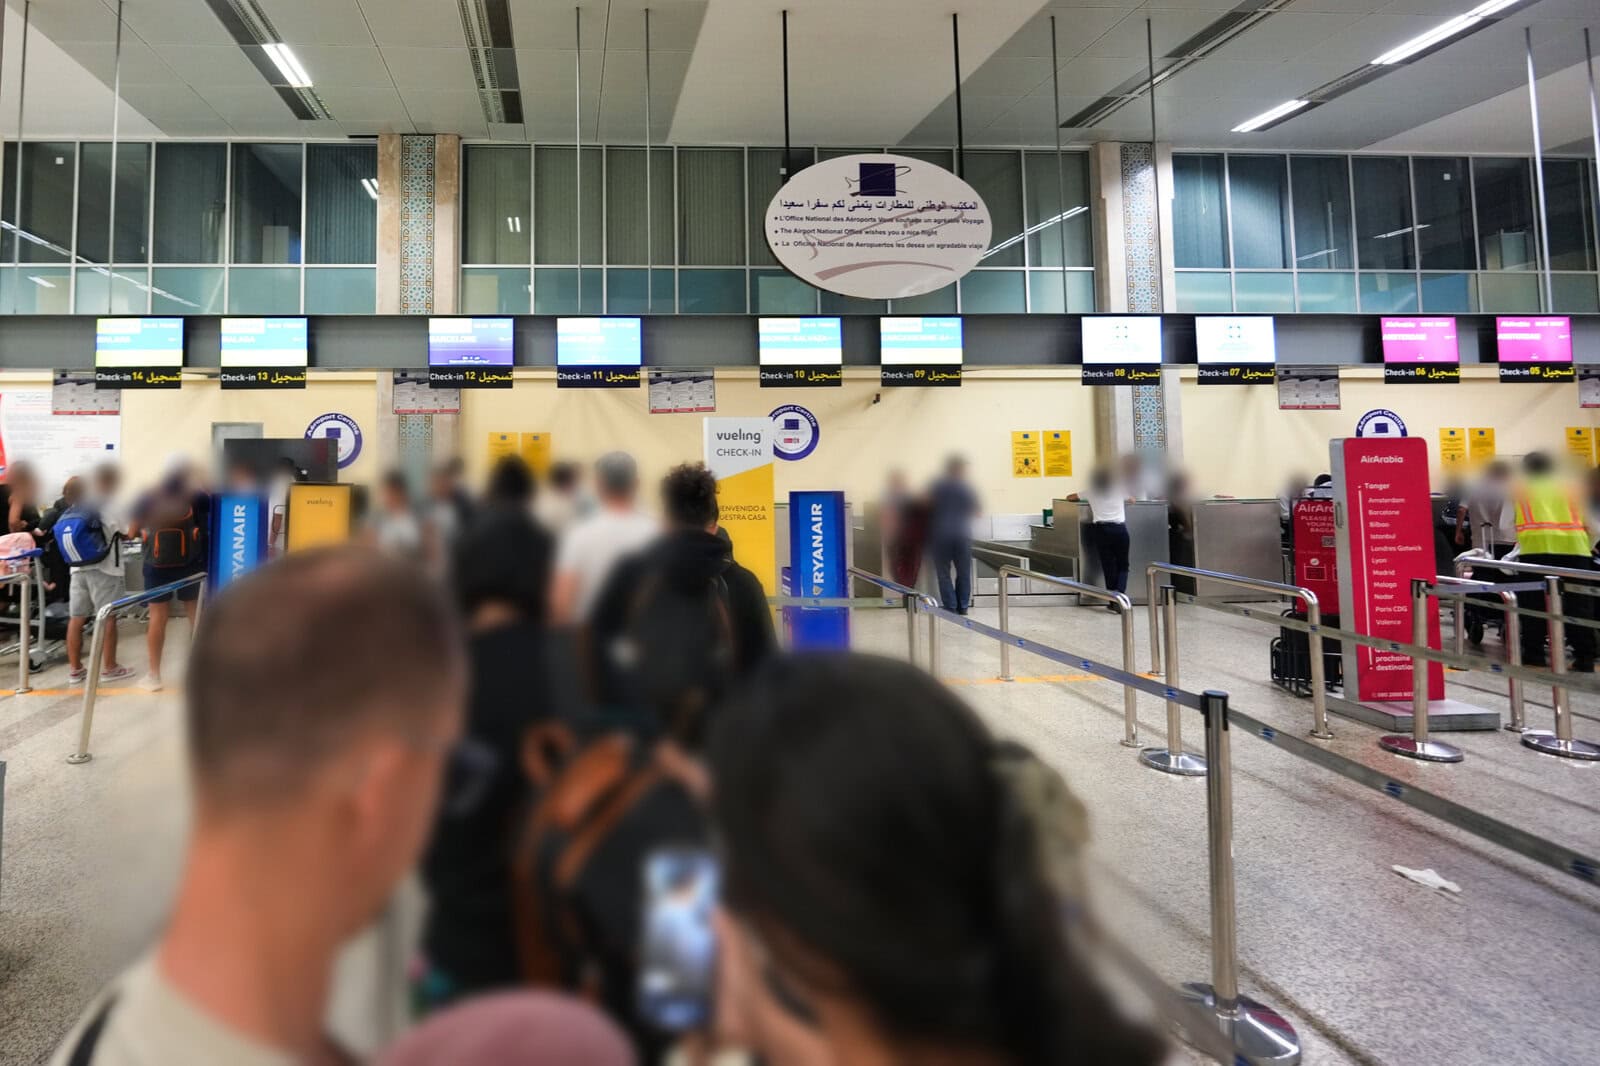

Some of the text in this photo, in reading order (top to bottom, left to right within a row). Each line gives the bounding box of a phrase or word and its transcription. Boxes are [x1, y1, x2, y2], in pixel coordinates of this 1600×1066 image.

[780, 200, 804, 210] سعيدا
[832, 200, 845, 211] لكم
[876, 200, 914, 211] للمطارات
[951, 200, 978, 212] المكتب
[96, 371, 182, 383] Check-in 14 تسجيل
[221, 371, 306, 383] Check-in 13 تسجيل
[465, 371, 476, 380] 12
[479, 371, 513, 383] تسجيل
[557, 371, 640, 382] Check-in 11 تسجيل
[794, 370, 805, 378] 10
[807, 370, 841, 382] تسجيل
[882, 370, 961, 381] Check-in 09 تسجيل
[1082, 368, 1160, 380] Check-in 08 تسجيل
[1229, 368, 1240, 376] 07
[1242, 368, 1275, 380] تسجيل
[1416, 367, 1426, 375] 06
[1427, 368, 1461, 379] تسجيل
[1530, 367, 1540, 375] 05
[1542, 367, 1575, 378] تسجيل
[716, 428, 761, 444] vueling
[716, 448, 762, 457] CHECK-IN
[1360, 455, 1404, 464] AirArabia
[1364, 482, 1390, 491] Tanger
[811, 503, 824, 584] RYANAIR
[1371, 557, 1387, 565] Lyon
[1375, 655, 1411, 663] prochaine
